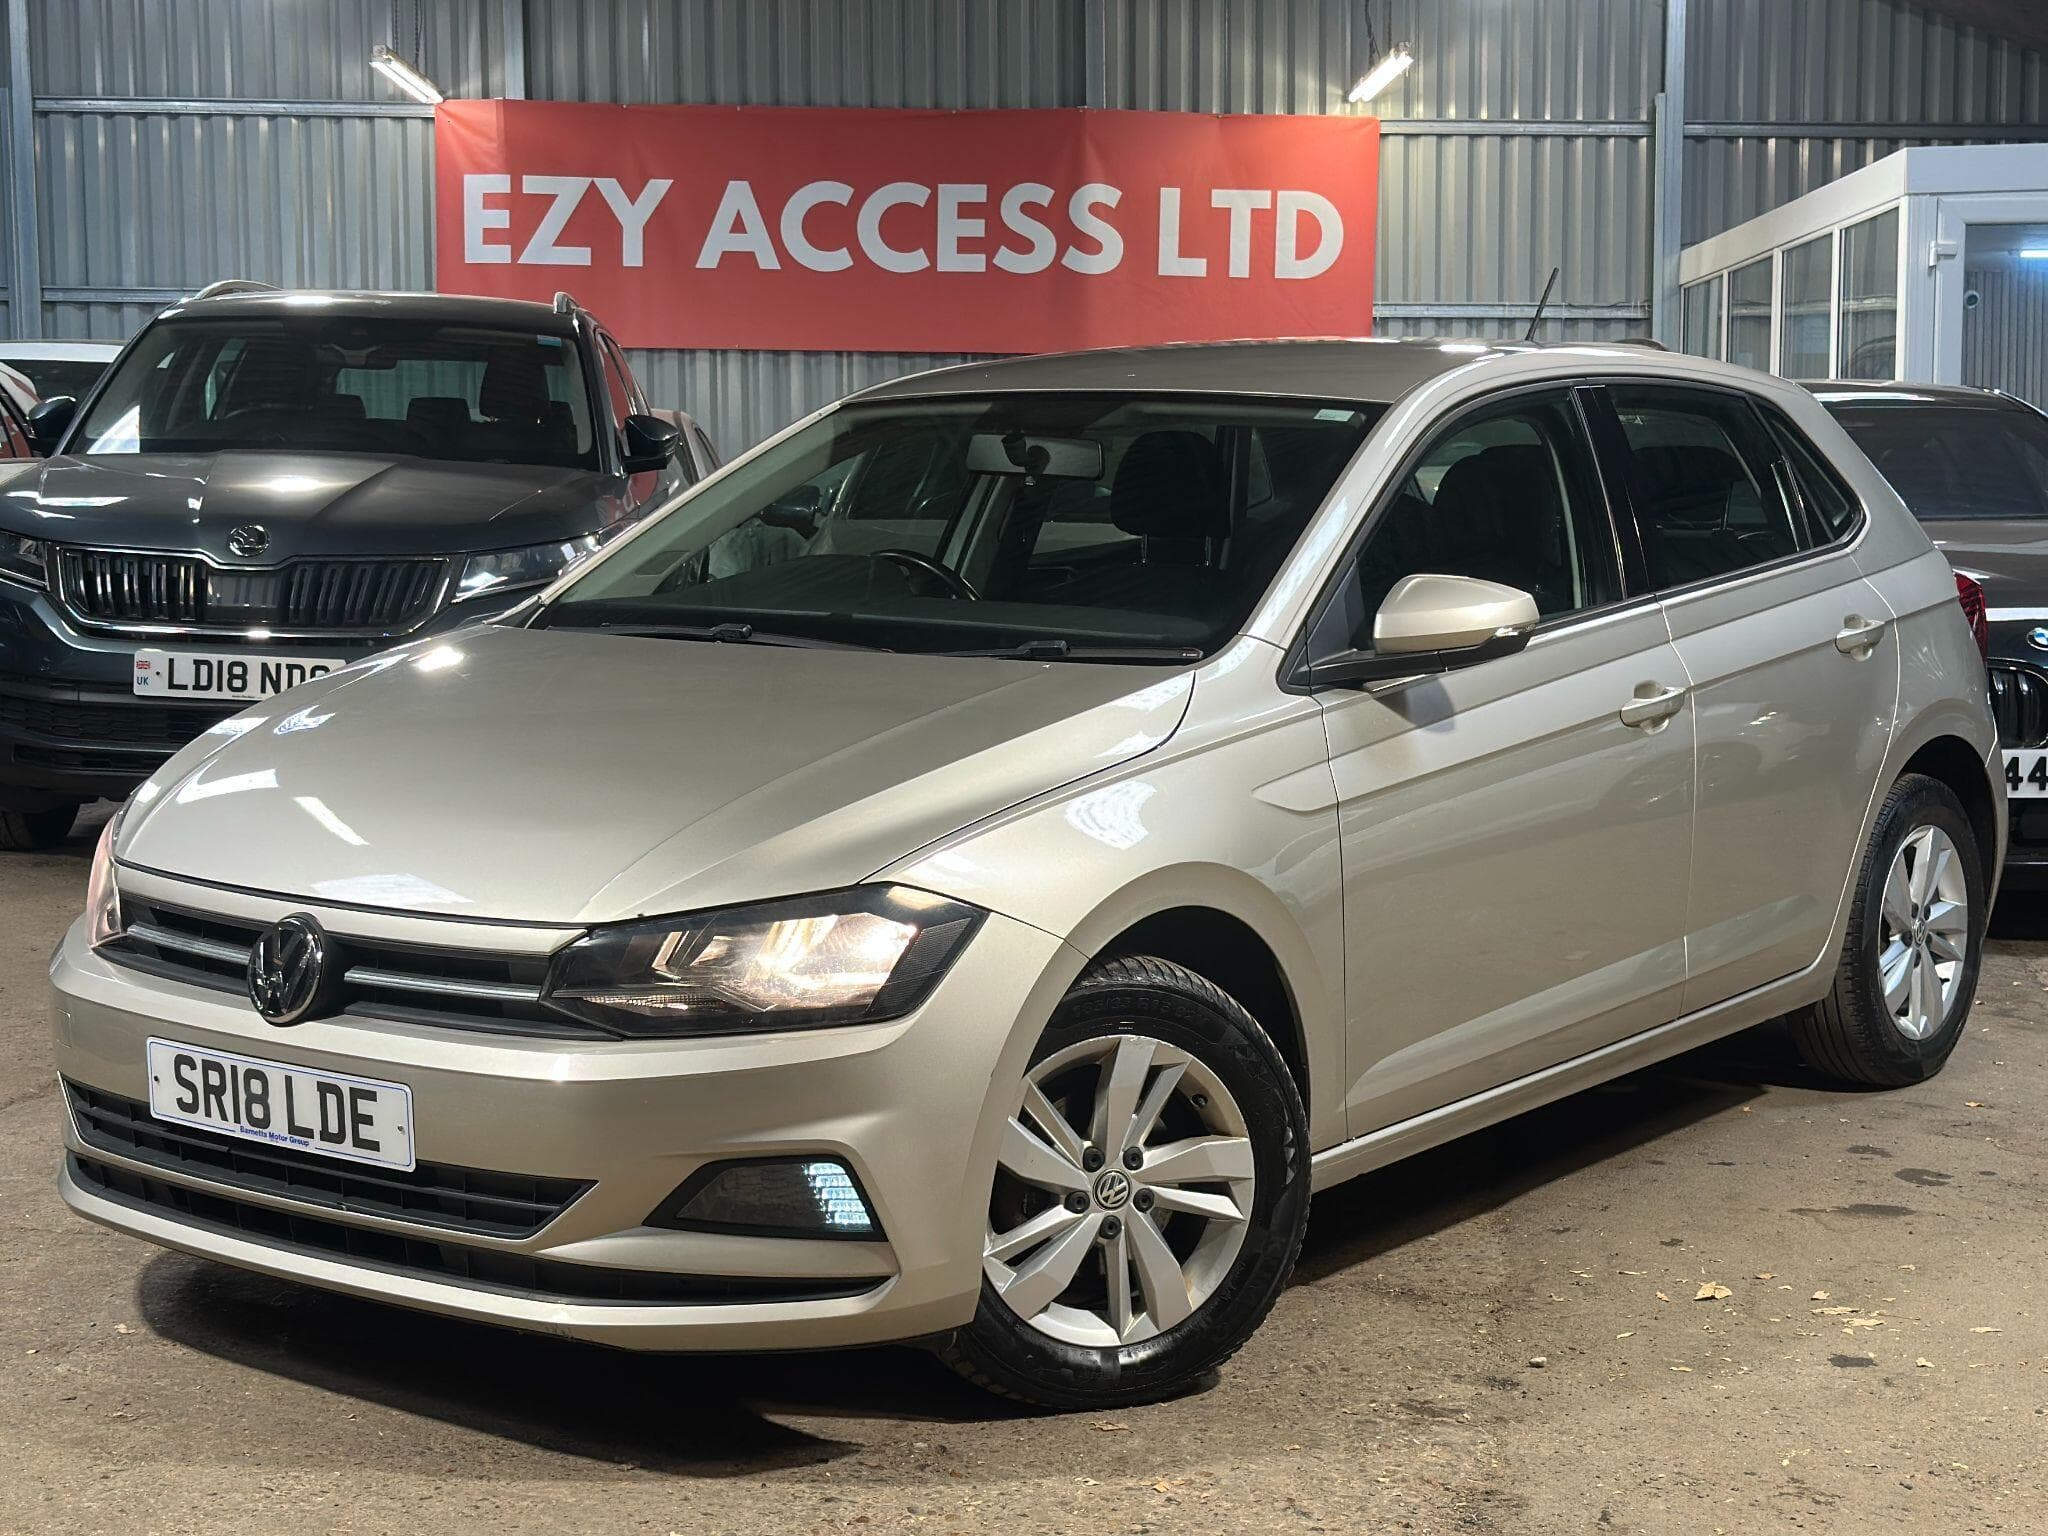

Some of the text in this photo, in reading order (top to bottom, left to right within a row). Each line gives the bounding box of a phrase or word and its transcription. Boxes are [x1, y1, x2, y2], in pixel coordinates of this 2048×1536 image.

[464, 174, 1344, 280] EZY ACCESS LTD
[136, 675, 149, 686] UK
[167, 658, 248, 693] LD18
[173, 1053, 381, 1153] SR18 LDE
[240, 1126, 267, 1138] Barnetts
[268, 1131, 288, 1142] Motor
[289, 1136, 310, 1148] Group
